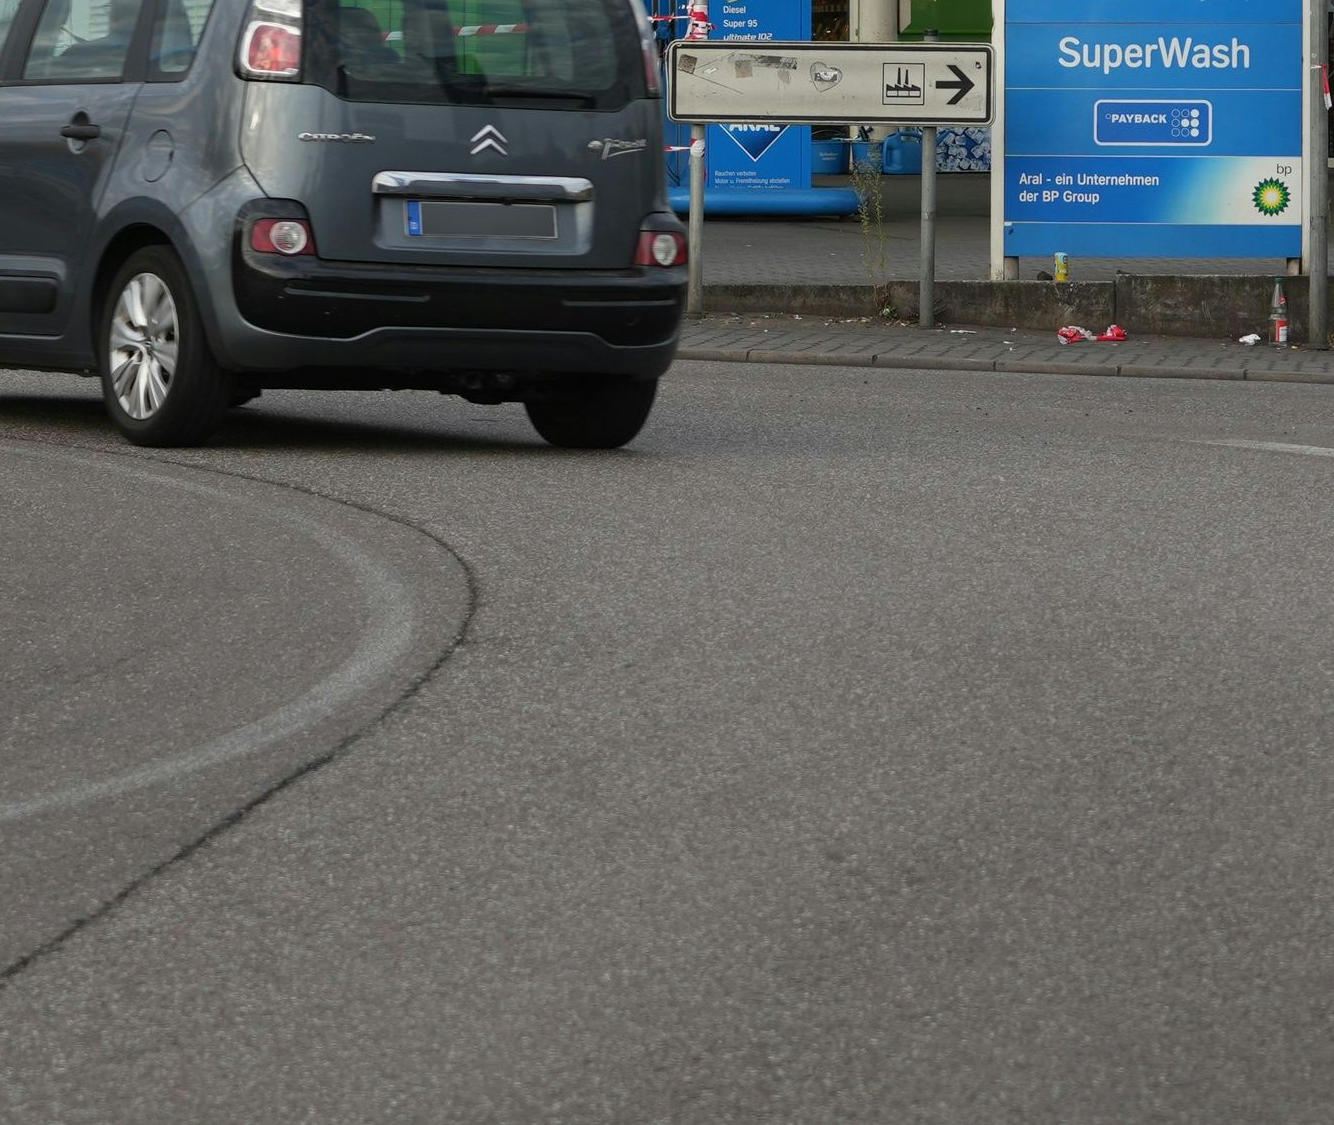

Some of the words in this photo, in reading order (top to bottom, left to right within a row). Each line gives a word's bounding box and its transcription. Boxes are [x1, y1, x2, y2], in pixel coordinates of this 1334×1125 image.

[723, 5, 747, 14] Diesel
[723, 19, 746, 28] Super
[747, 19, 759, 27] 95
[758, 32, 773, 40] 102
[1058, 36, 1250, 75] SuperWash
[1111, 113, 1168, 124] PAYBACK
[1276, 163, 1293, 176] bp
[1019, 173, 1043, 186] Aral
[1055, 174, 1073, 186] ein
[1077, 173, 1160, 187] Unternehmen
[1019, 190, 1038, 203] der
[1042, 191, 1059, 203] BP
[1063, 191, 1100, 205] Group
